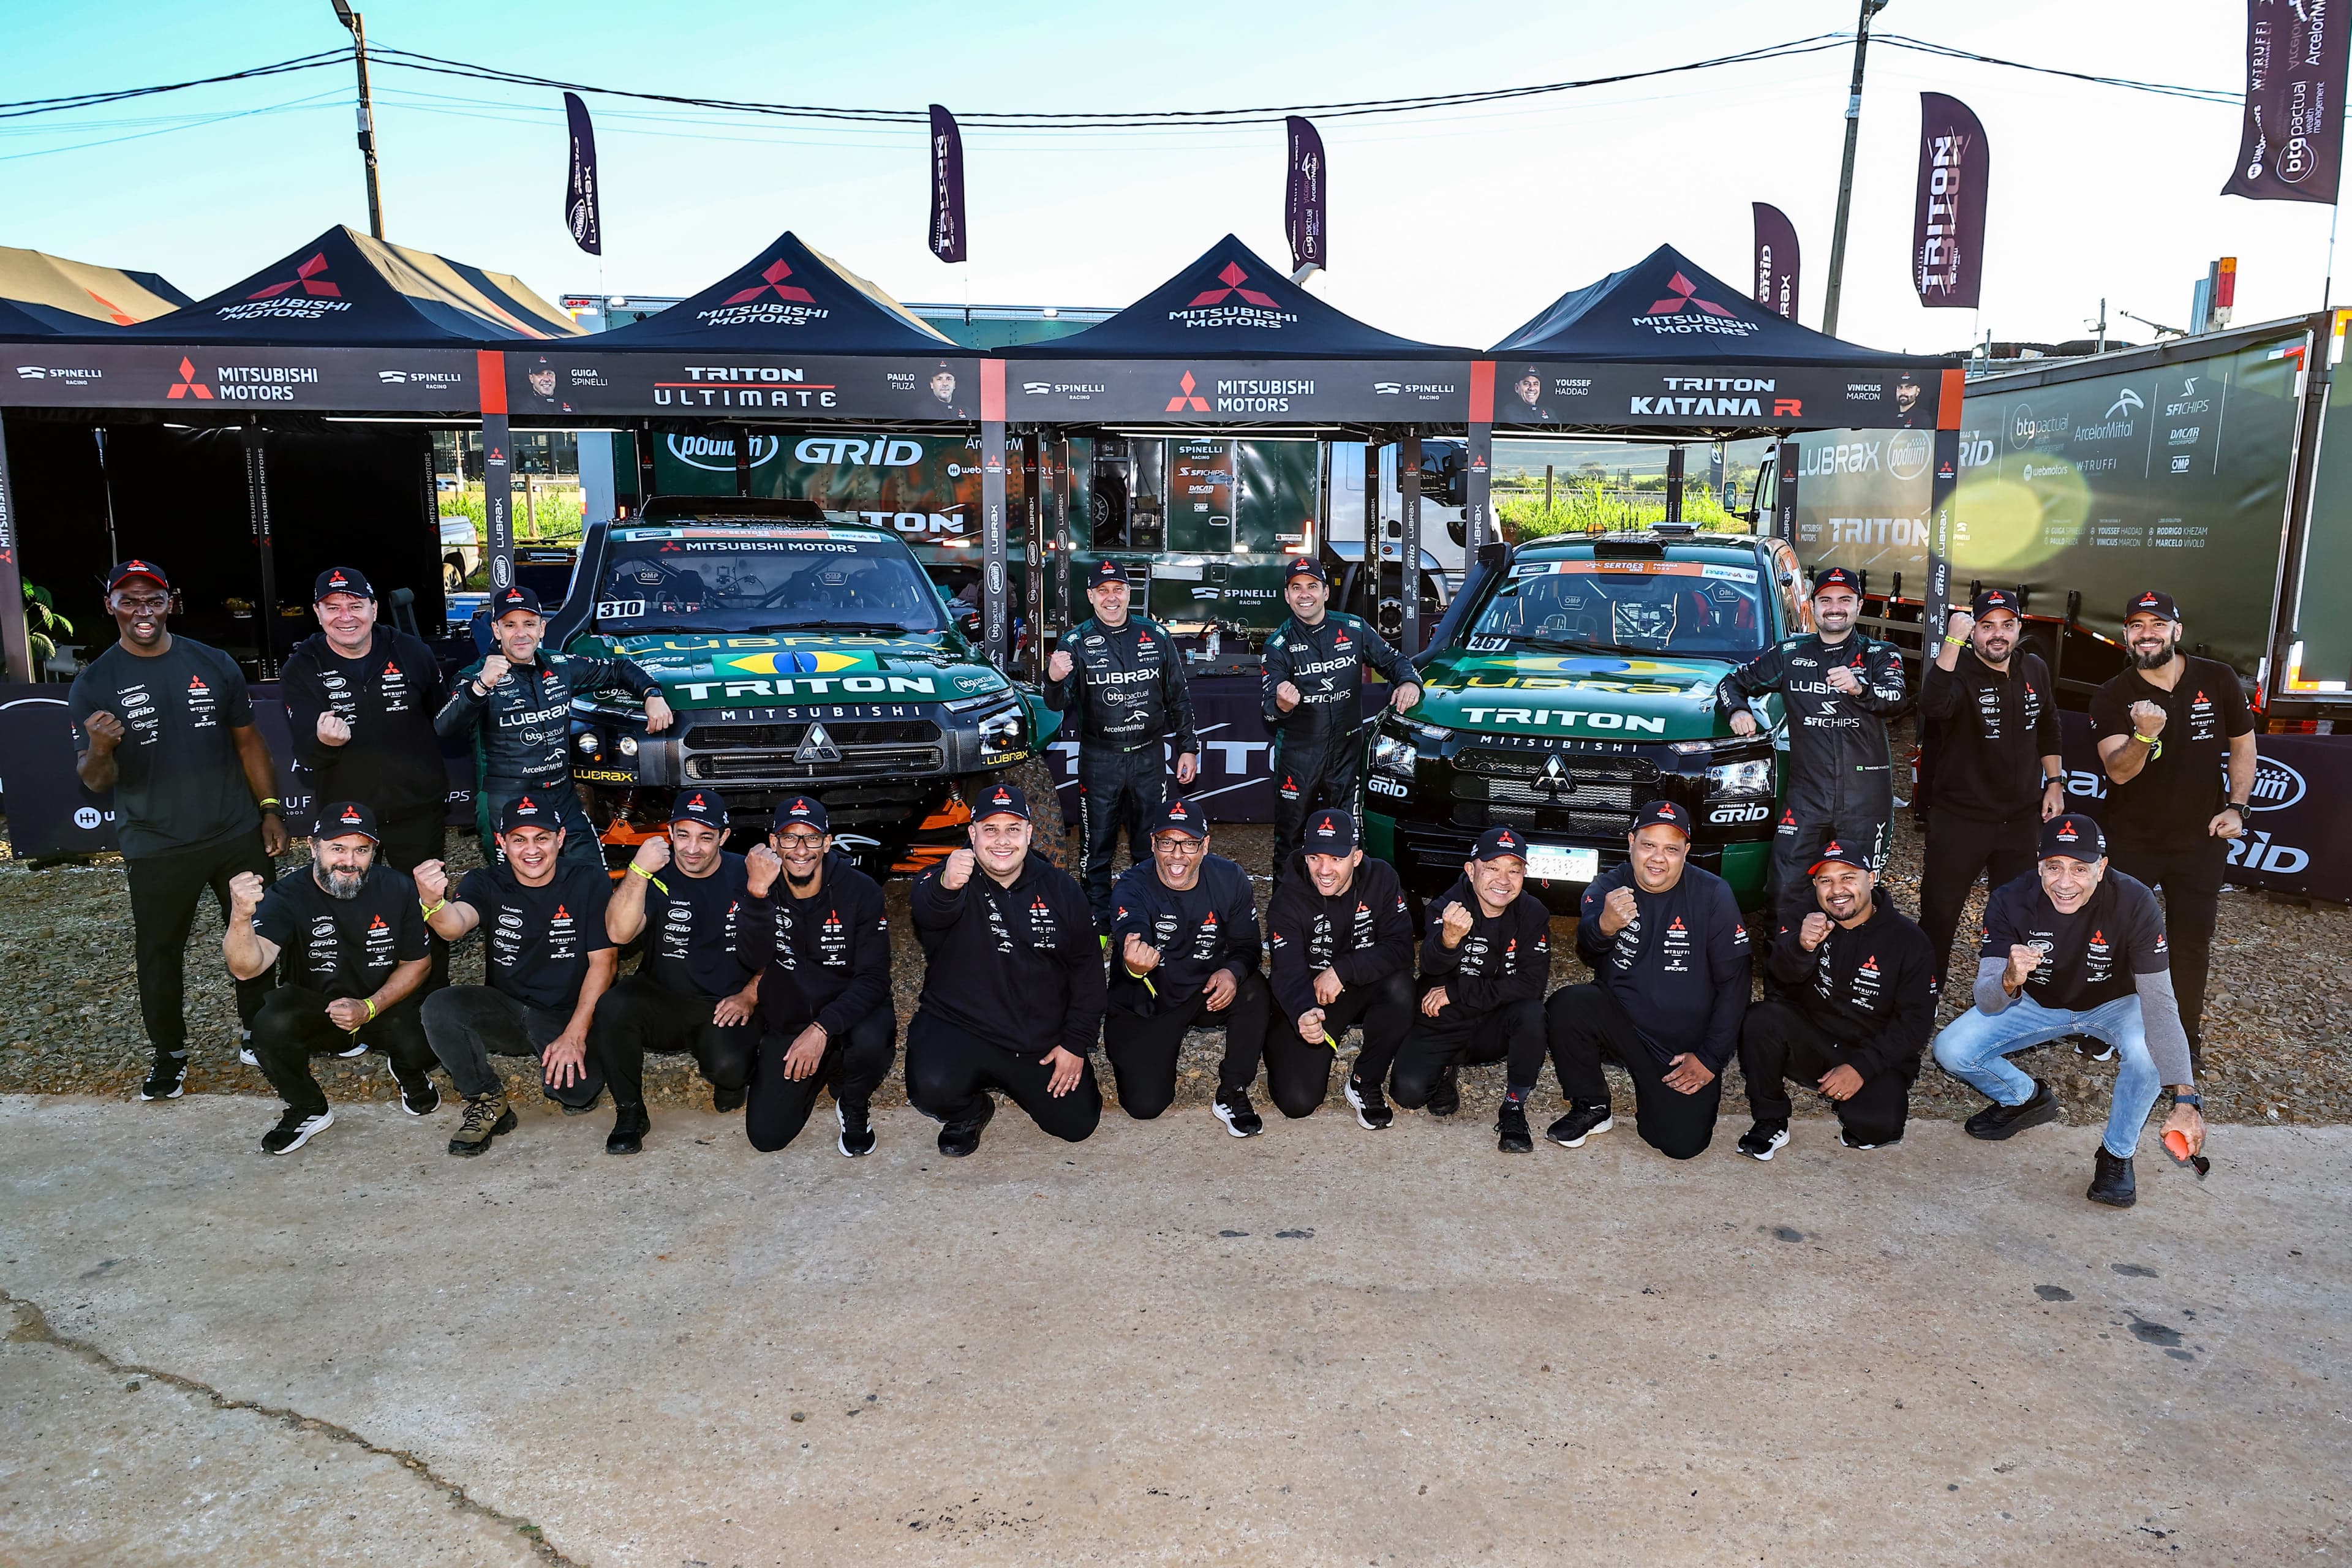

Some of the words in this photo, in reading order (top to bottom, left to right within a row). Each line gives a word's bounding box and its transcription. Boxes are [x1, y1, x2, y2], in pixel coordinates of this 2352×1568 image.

[2291, 80, 2307, 137] pactual
[2312, 81, 2326, 134] management
[2286, 138, 2307, 173] btg
[1922, 136, 1951, 294] TRITON
[215, 297, 352, 315] MITSUBISHI
[696, 303, 829, 320] MITSUBISHI
[221, 308, 325, 321] MOTORS
[708, 314, 807, 326] MOTORS
[1169, 306, 1298, 323] MITSUBISHI
[1186, 317, 1283, 328] MOTORS
[1632, 314, 1759, 331] MITSUBISHI
[1654, 324, 1750, 337] MOTORS
[50, 369, 102, 378] SPINELLI
[218, 367, 318, 383] MITSUBISHI
[410, 372, 461, 382] SPINELLI
[571, 369, 598, 377] GUIGA
[685, 367, 804, 382] TRITON
[887, 372, 915, 382] PAULO
[891, 382, 915, 390] FIUZA
[1055, 383, 1106, 393] SPINELLI
[1217, 380, 1314, 395] MITSUBISHI
[1404, 383, 1455, 393] SPINELLI
[1555, 379, 1591, 387] YOUSSEF
[1663, 377, 1775, 392] TRITON
[1847, 383, 1882, 392] VINICIUS
[220, 385, 294, 401] MOTORS
[654, 389, 837, 408] ULTIMATE
[1555, 388, 1588, 396] HADDAD
[1217, 398, 1289, 413] MOTORS
[1630, 396, 1762, 417] KATANA
[1773, 399, 1802, 417] R
[2166, 400, 2210, 417] SFICHIPS
[2016, 417, 2035, 440] btg
[2035, 413, 2070, 435] pactual
[2075, 420, 2133, 442] ArcelorMittal
[2170, 427, 2199, 439] DACAR
[794, 435, 923, 467] GRID
[1891, 445, 1926, 469] podium
[424, 452, 434, 483] MOTORS
[2033, 465, 2068, 477] webmotors
[2171, 458, 2190, 470] OMP
[261, 484, 270, 535] MITSUBISHI
[1828, 518, 1931, 547] TRITON
[2183, 527, 2208, 536] KHEZAM
[686, 541, 784, 551] MITSUBISHI
[788, 543, 858, 553] MOTORS
[1937, 564, 1946, 597] GRID
[1224, 589, 1276, 598] SPINELLI
[600, 601, 641, 617] 310
[991, 624, 1000, 638] btg
[1289, 644, 1309, 653] GRID
[1471, 636, 1506, 649] 467
[1792, 658, 1819, 668] GRID
[674, 677, 936, 701] TRITON
[959, 677, 975, 689] btg
[974, 674, 994, 687] pactual
[1107, 692, 1124, 702] btg
[1124, 688, 1149, 701] pactual
[1303, 689, 1351, 704] SFICHIPS
[127, 706, 156, 719] GRID
[721, 706, 920, 721] MITSUBISHI
[1103, 723, 1145, 733] ArcelorMittal
[1461, 707, 1666, 734] TRITON
[1803, 716, 1860, 728] SFICHIPS
[525, 728, 543, 742] btg
[1480, 735, 1638, 752] MITSUBISHI
[1368, 777, 1408, 797] GRID
[1709, 802, 1770, 823] GRID
[494, 928, 522, 940] GRID
[664, 923, 692, 932] GRID
[309, 938, 337, 948] GRID
